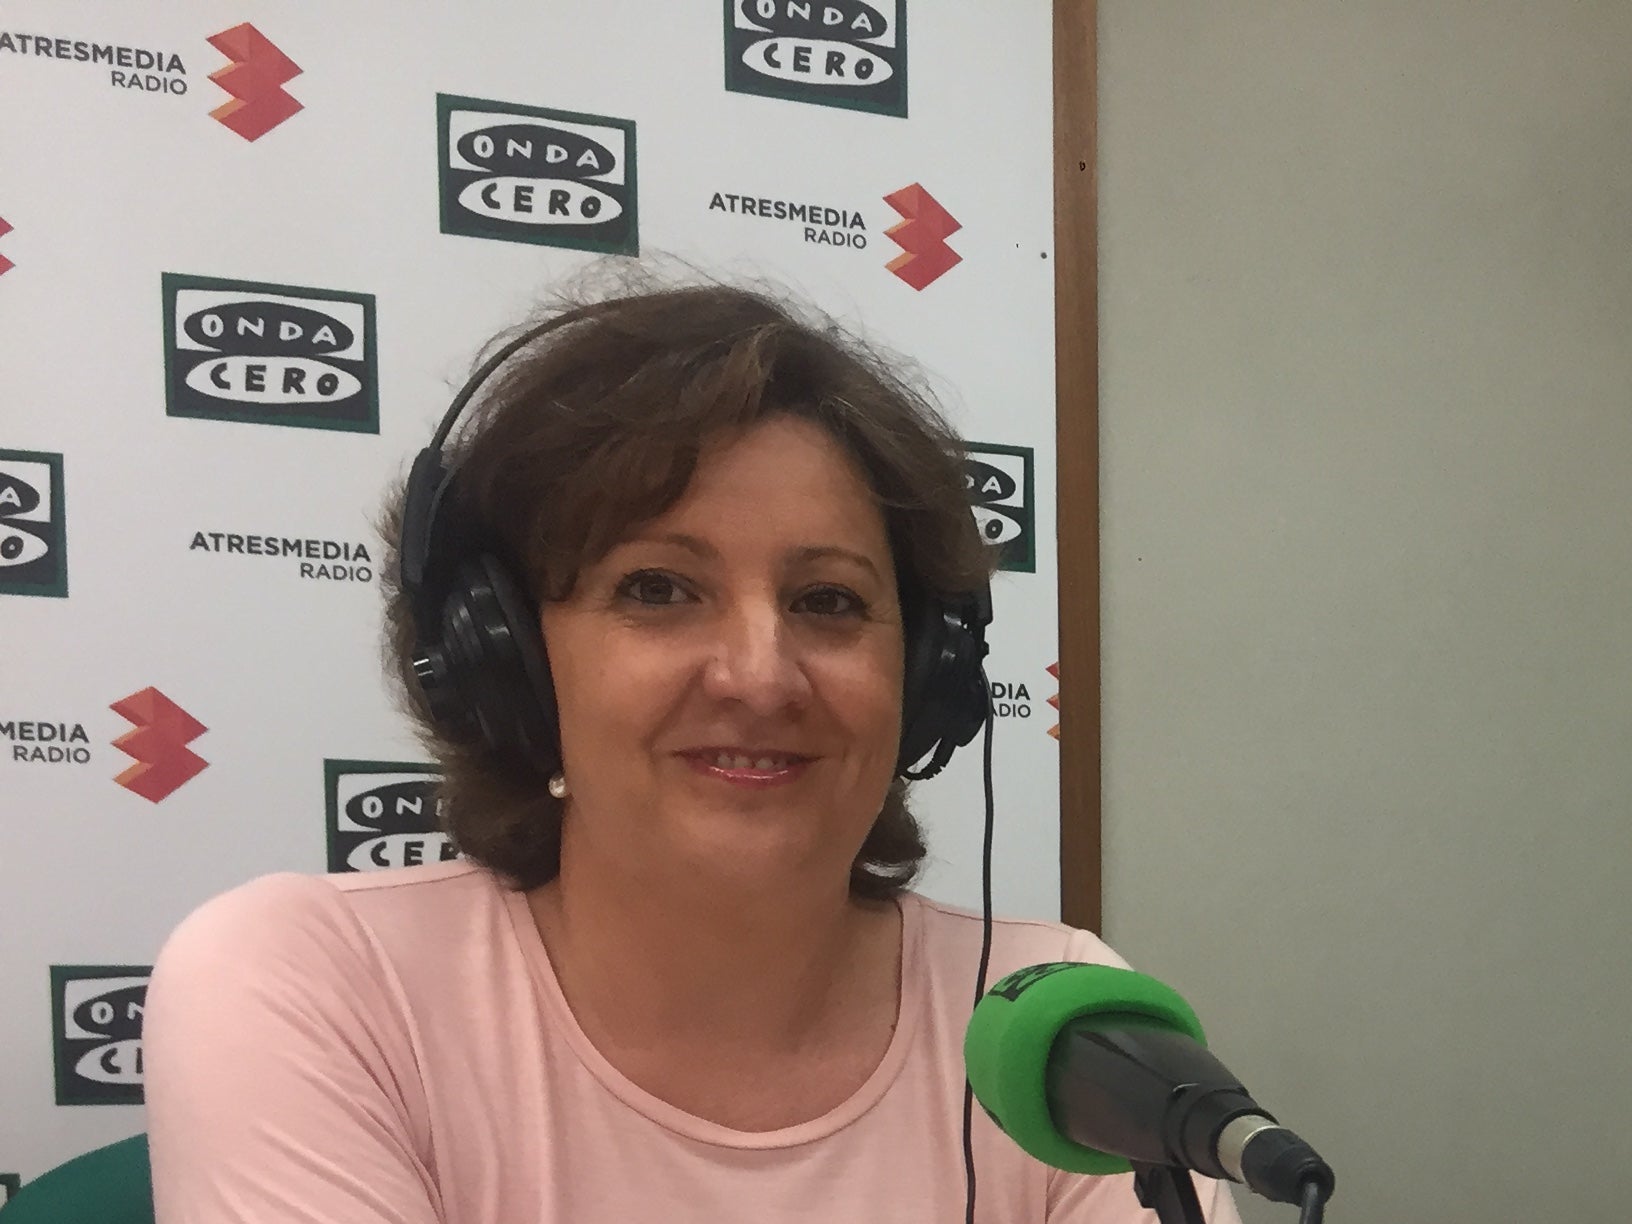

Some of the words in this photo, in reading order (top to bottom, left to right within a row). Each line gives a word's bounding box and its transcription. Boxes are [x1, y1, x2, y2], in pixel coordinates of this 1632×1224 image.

[756, 0, 873, 33] ONDA
[0, 31, 187, 75] ATRESMEDIA
[763, 42, 875, 80] CERO
[110, 69, 188, 96] RADIO
[473, 134, 600, 170] ONDA
[481, 182, 601, 219] CERO
[708, 191, 867, 231] ATRESMEDIA
[804, 226, 867, 250] RADIO
[201, 313, 338, 346] ONDA
[209, 361, 340, 397] CERO
[189, 530, 372, 563] ATRESMEDIA
[299, 562, 373, 583] RADIO
[992, 703, 1032, 719] DIO
[13, 744, 91, 764] RADIO
[370, 840, 459, 868] CER
